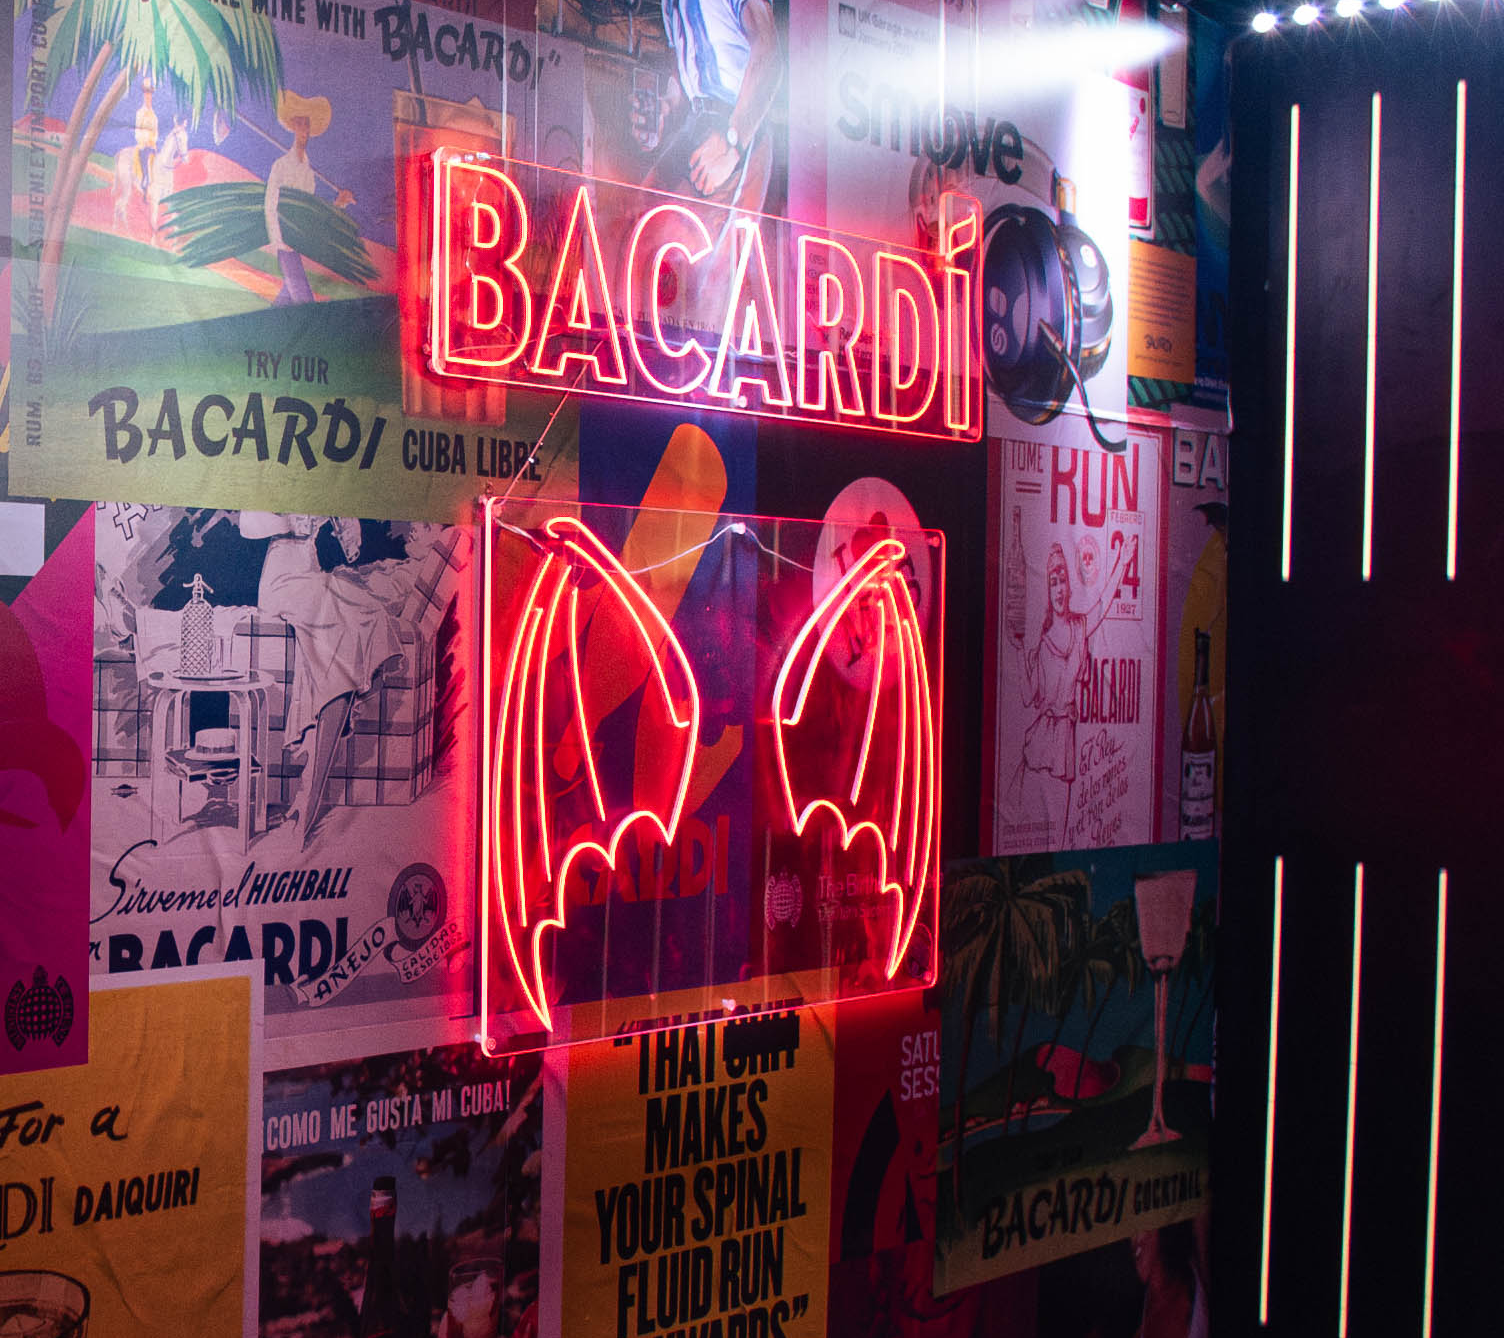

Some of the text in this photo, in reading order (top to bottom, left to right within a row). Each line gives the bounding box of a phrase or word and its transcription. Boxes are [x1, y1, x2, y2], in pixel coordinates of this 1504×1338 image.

[244, 348, 330, 386] TRY OUR
[88, 386, 543, 482] BACARDI CUBA LIBRE
[1110, 529, 1141, 600] 24
[1079, 657, 1142, 725] BACARDI
[222, 861, 255, 908] el
[245, 867, 354, 906] HIGHBALL
[314, 926, 387, 1001] AÑEJO
[90, 1103, 129, 1143] a
[265, 1080, 512, 1152] COMO ME GUSTA MI CUBA!
[644, 1081, 768, 1175] MAKES
[71, 1166, 201, 1229] DAIQUIRI
[594, 1146, 807, 1267] YOUR SPINAL
[979, 1172, 1130, 1261] BACARDI
[719, 1226, 784, 1305] RUN
